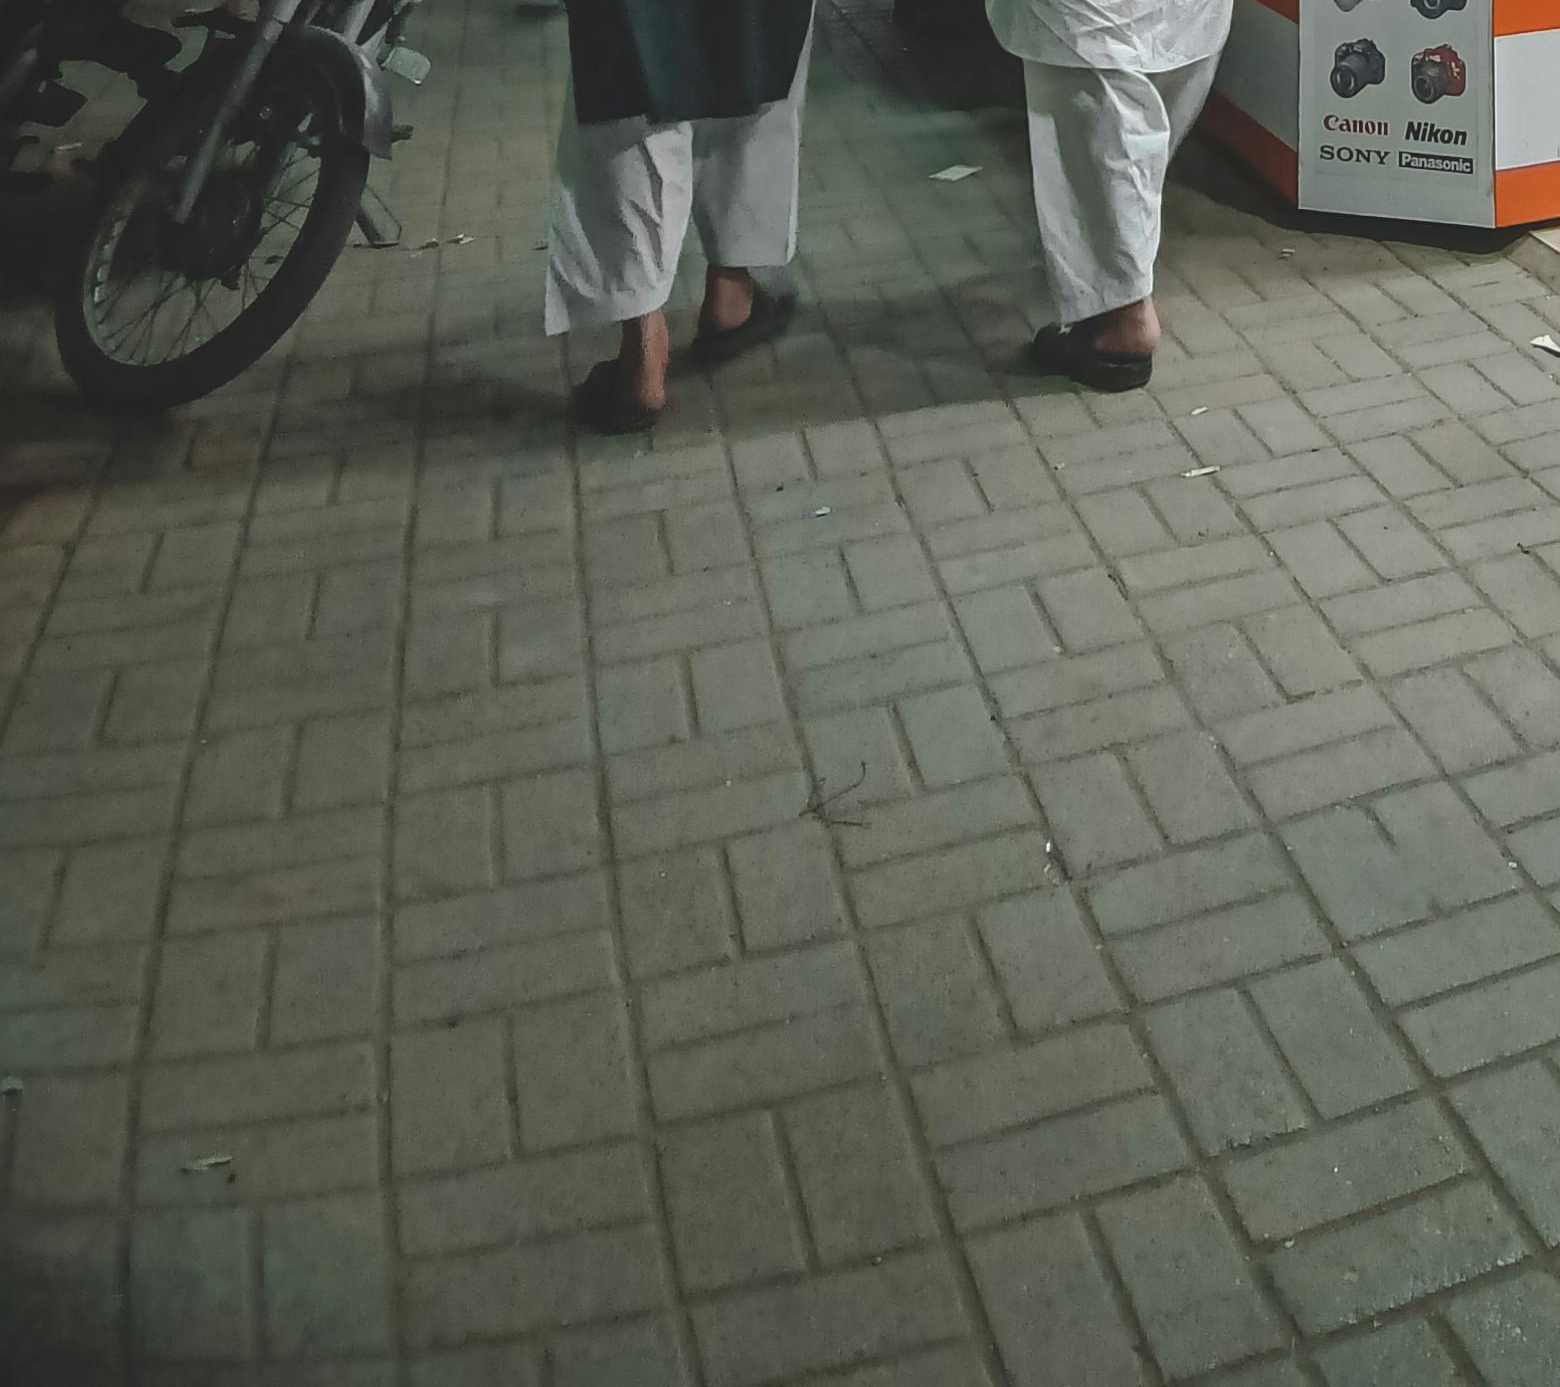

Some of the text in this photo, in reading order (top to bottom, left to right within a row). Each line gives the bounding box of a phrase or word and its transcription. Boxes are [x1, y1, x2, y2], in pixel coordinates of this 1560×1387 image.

[1323, 114, 1468, 146] Canon Nikon
[1319, 145, 1472, 173] SONY Panasonic
